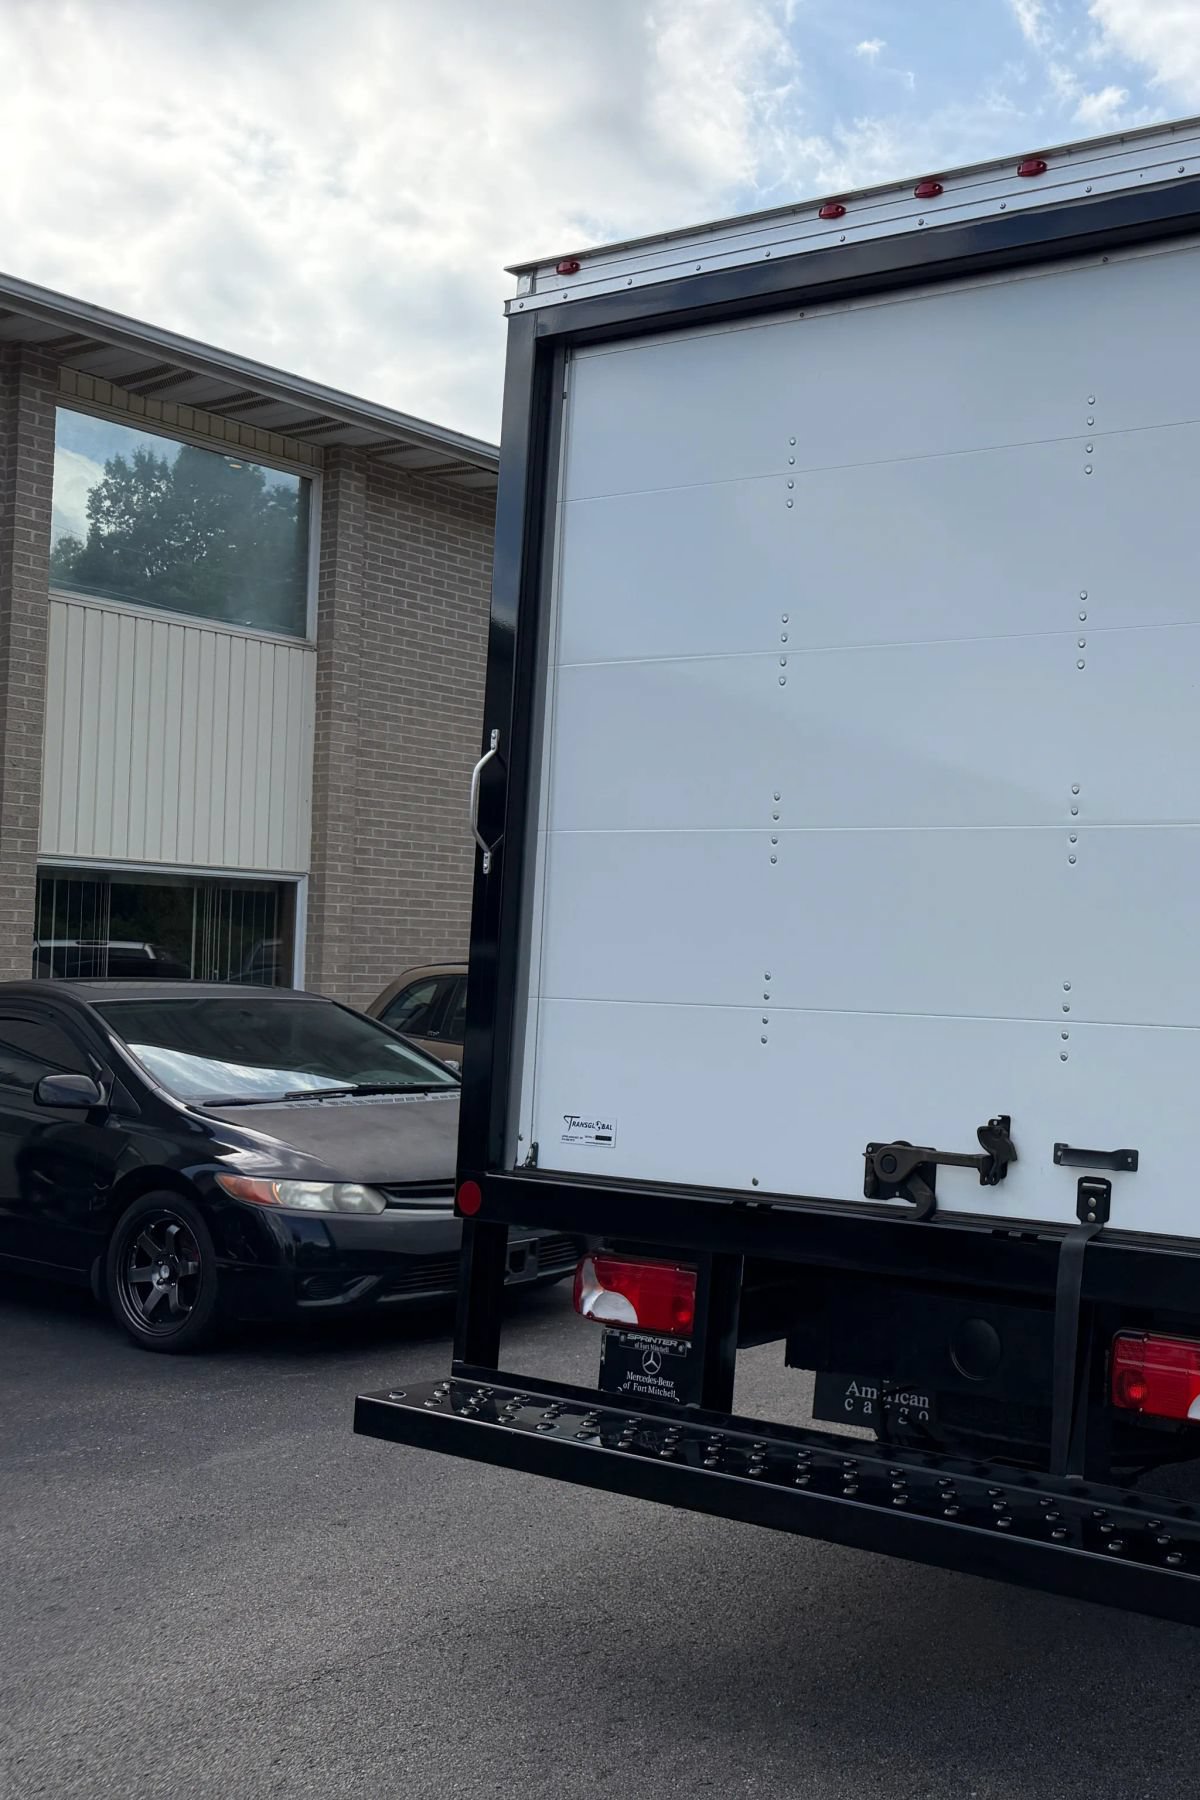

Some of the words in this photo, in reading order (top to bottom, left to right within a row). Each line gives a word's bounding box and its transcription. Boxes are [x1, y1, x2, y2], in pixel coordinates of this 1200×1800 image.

[627, 1333, 678, 1347] SPRINTER
[626, 1371, 675, 1387] Mercedes-Benz
[623, 1381, 631, 1389] of
[633, 1382, 647, 1393] Fort
[648, 1385, 676, 1398] Mitchell
